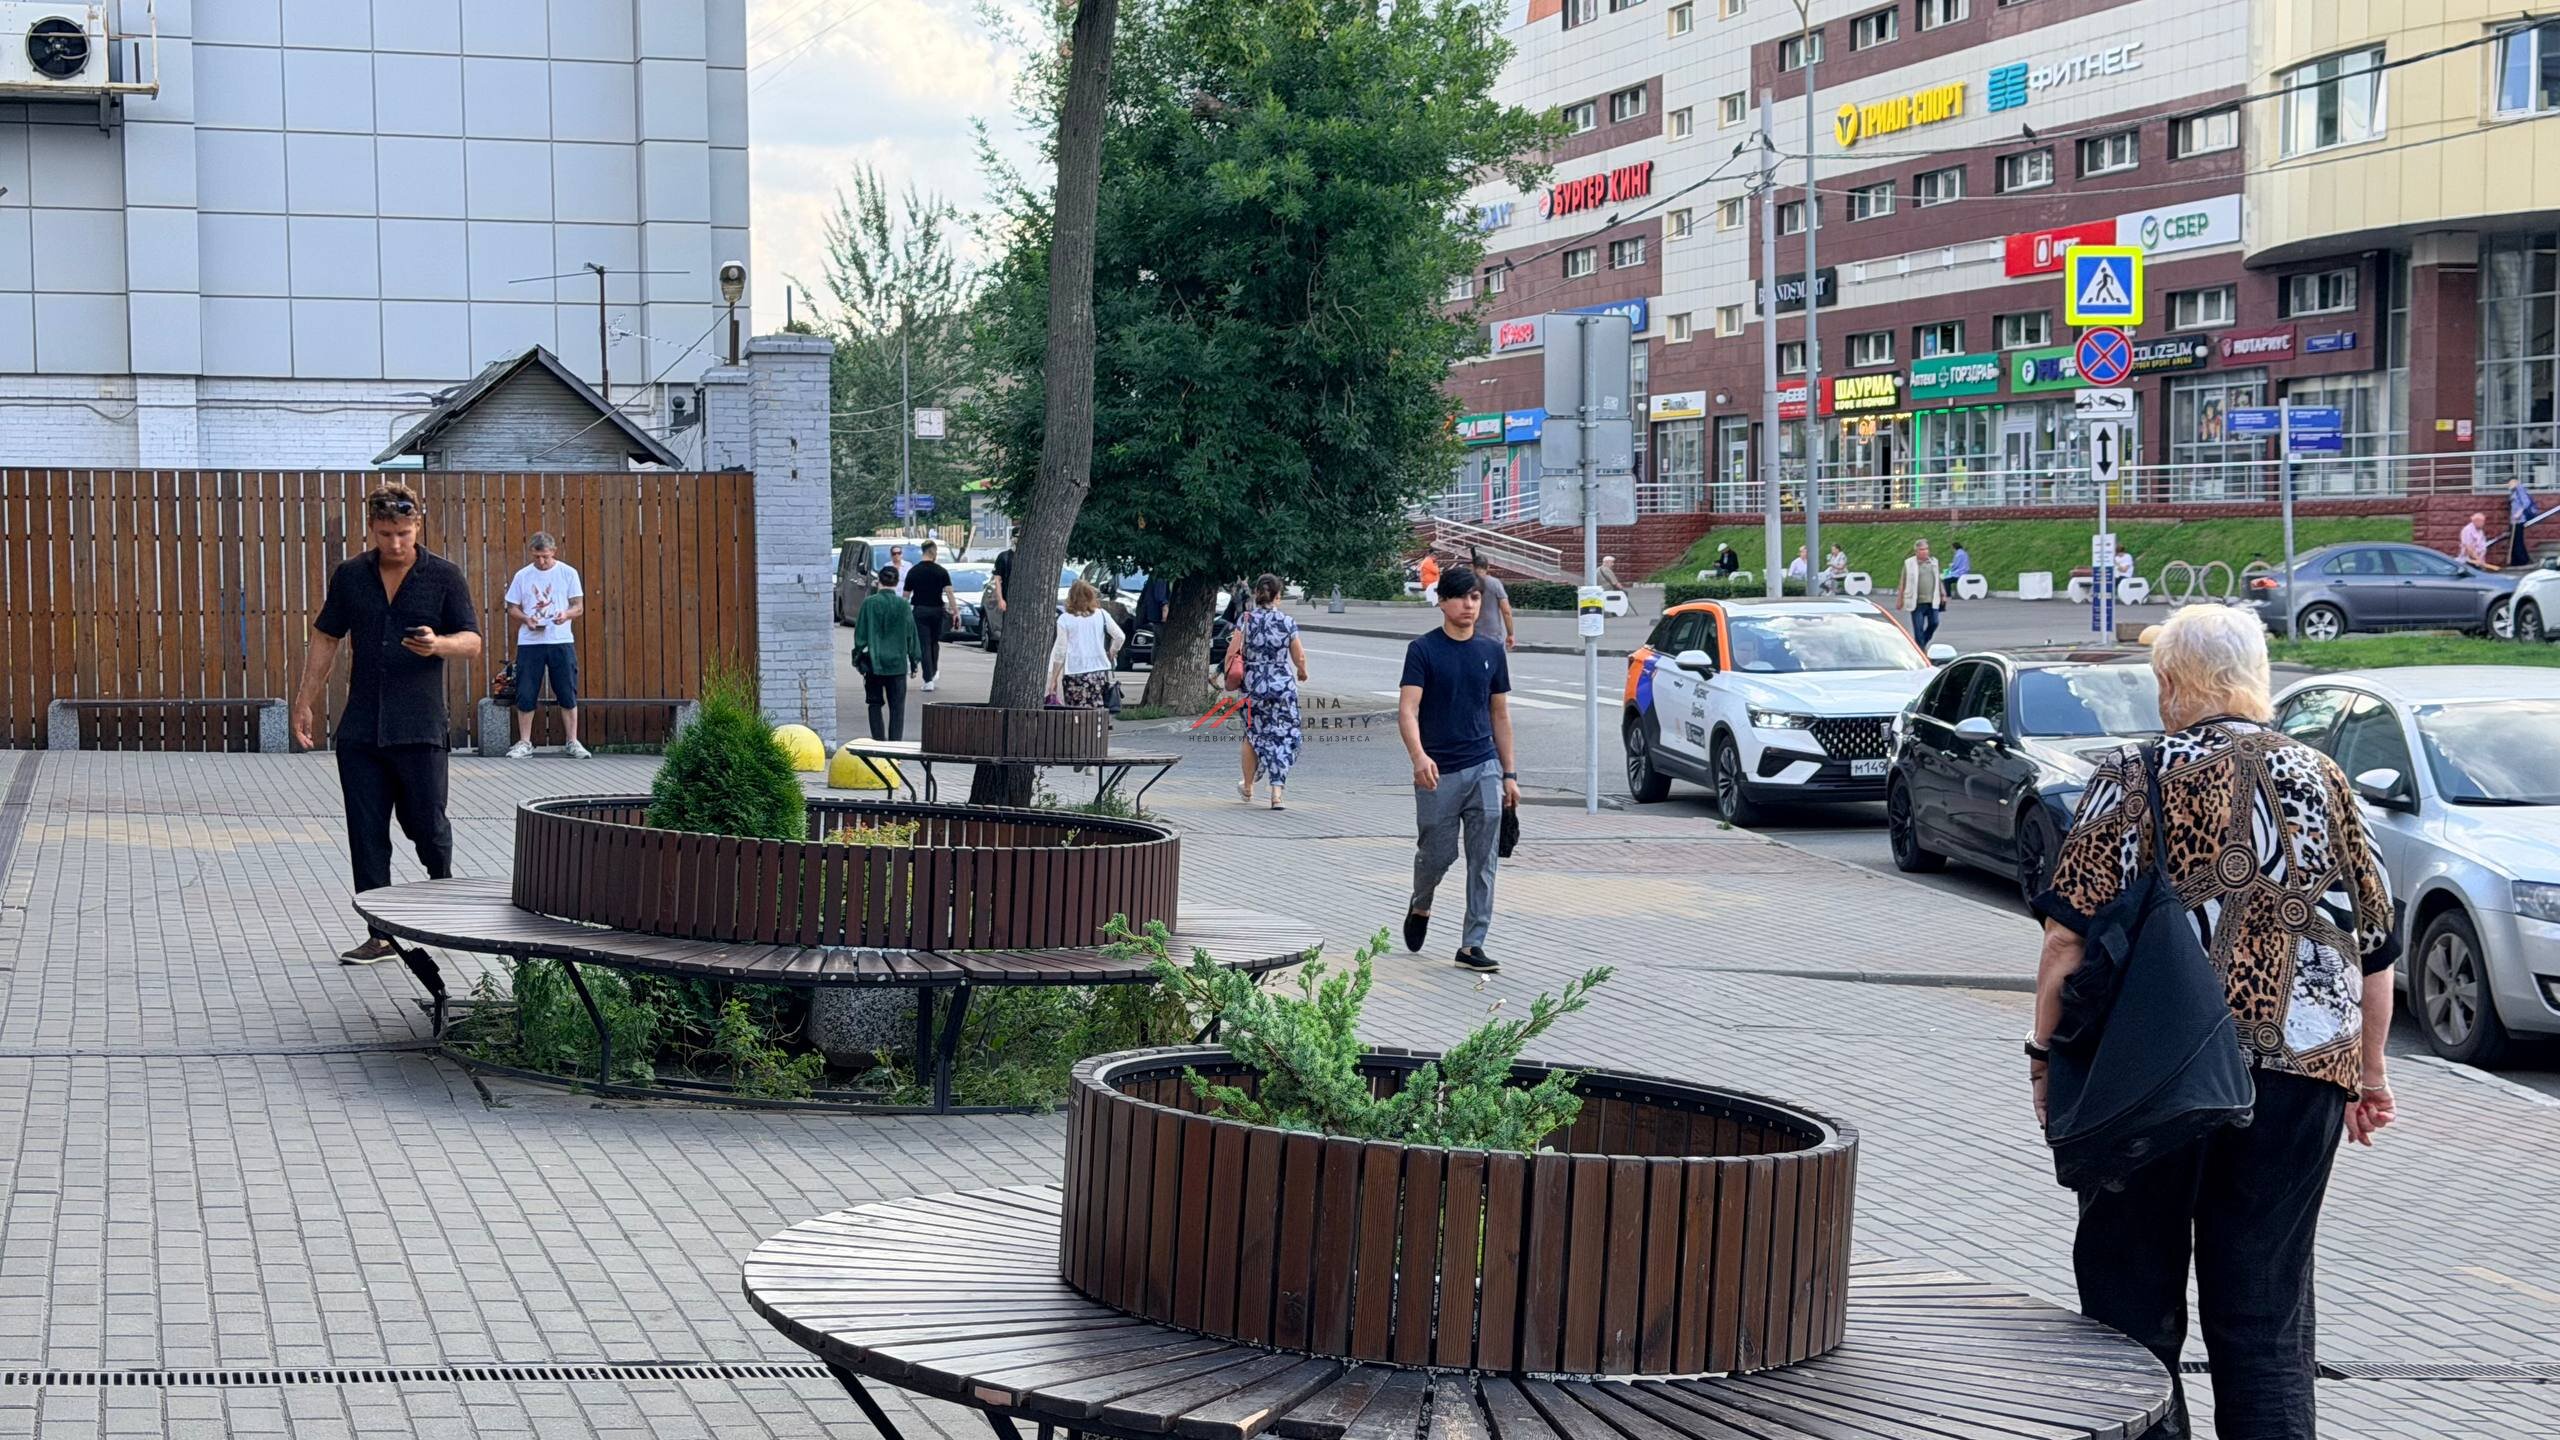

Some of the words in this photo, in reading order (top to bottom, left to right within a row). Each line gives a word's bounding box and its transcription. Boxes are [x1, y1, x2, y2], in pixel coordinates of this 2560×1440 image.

[2028, 42, 2144, 91] ФИТНЕС
[1859, 80, 1967, 138] ТРИАЛ-СПОРТ
[1553, 173, 1606, 217] БУРГЕР
[1609, 161, 1653, 203] КИНГ
[2164, 212, 2209, 240] СБЕР
[1758, 277, 1826, 305] BNDSMT
[2233, 334, 2291, 354] НОТАРИУС
[1835, 374, 1895, 400] ШАУРМА
[1910, 370, 1937, 388] Аптеки
